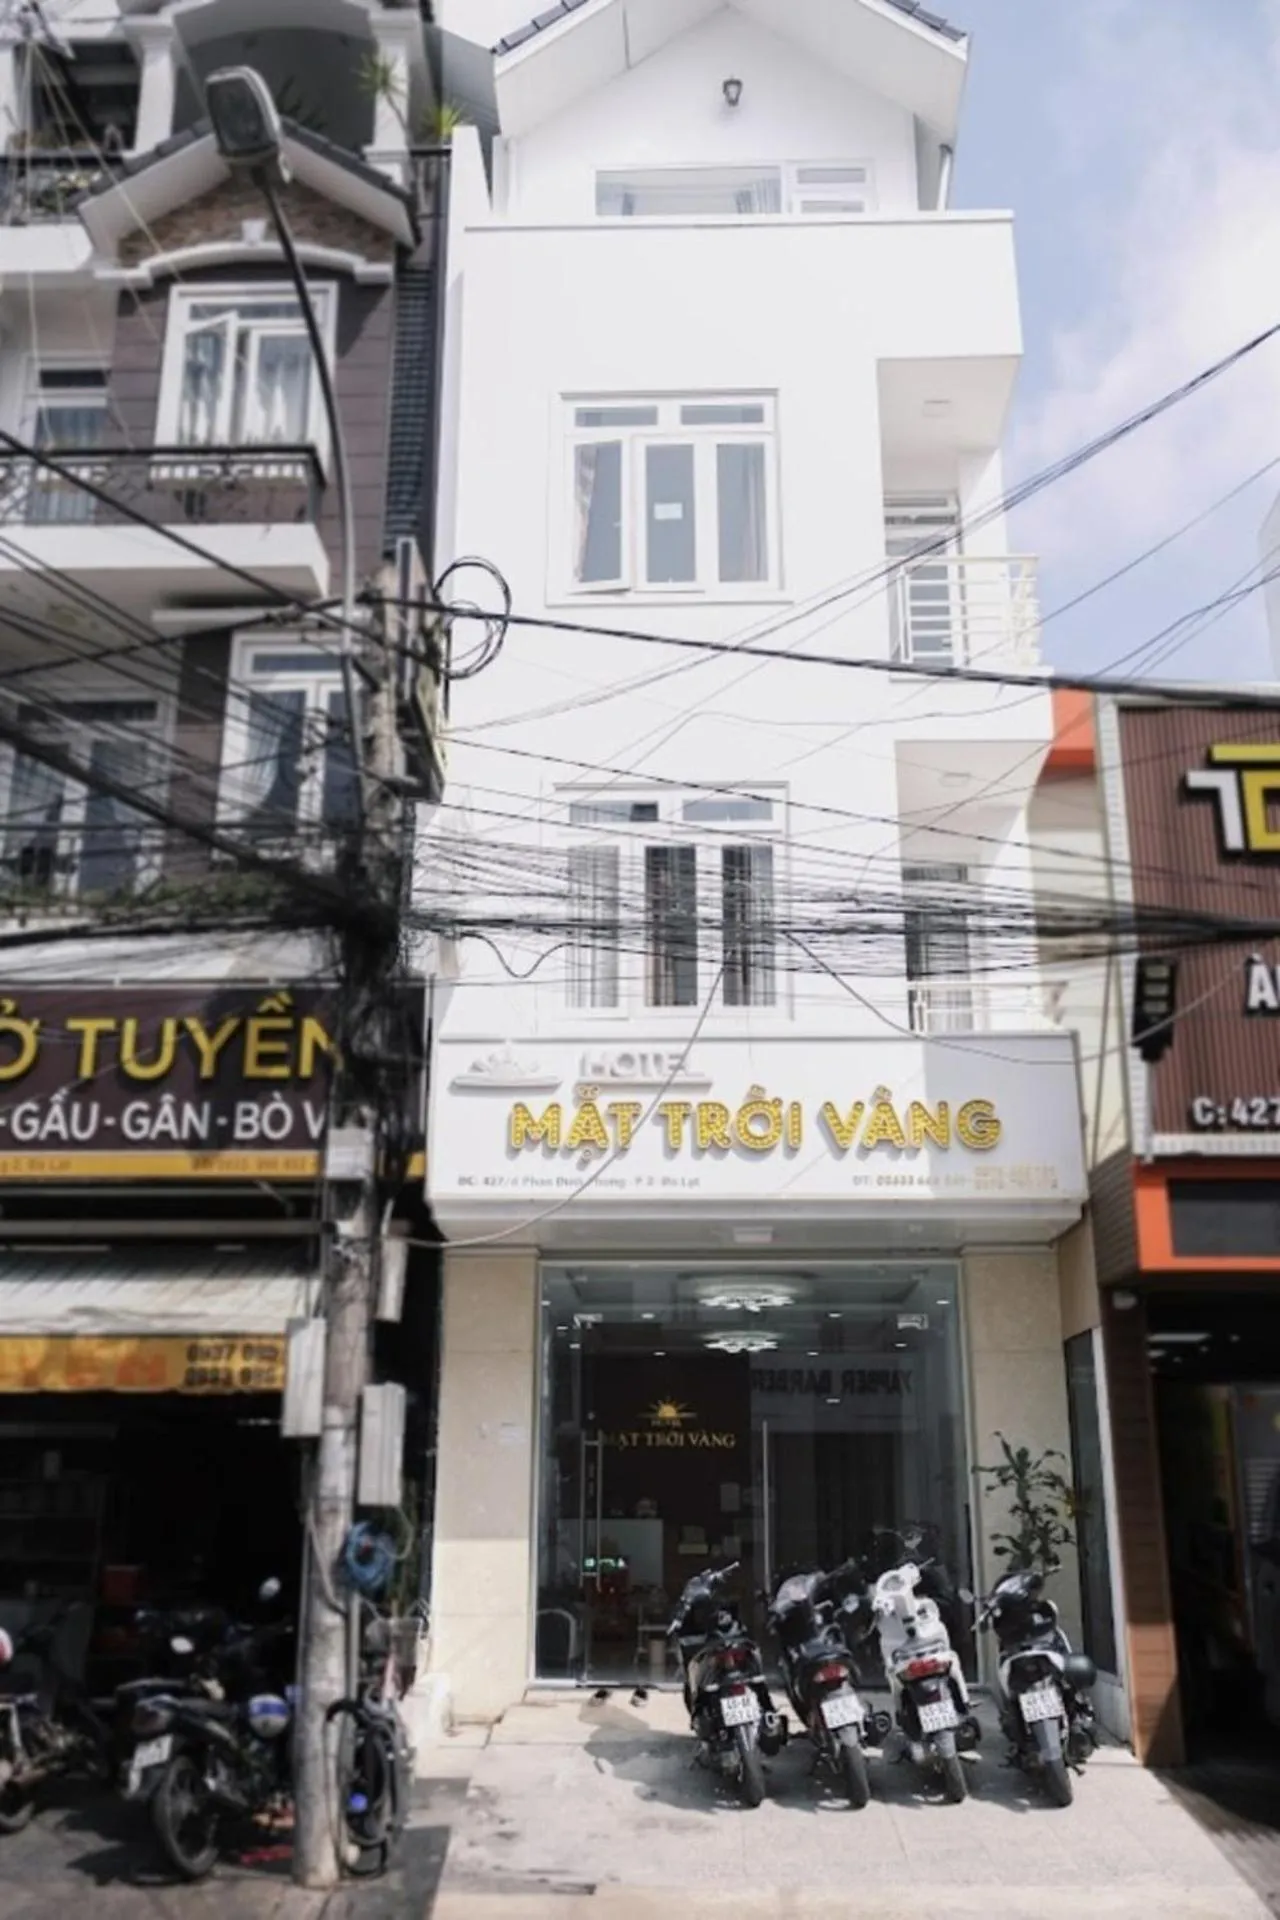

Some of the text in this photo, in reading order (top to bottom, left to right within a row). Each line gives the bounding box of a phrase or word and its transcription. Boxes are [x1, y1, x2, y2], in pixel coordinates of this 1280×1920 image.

[66, 992, 343, 1080] TUYỀN
[658, 1083, 802, 1150] TRỜI
[822, 1084, 1002, 1150] VÀNG
